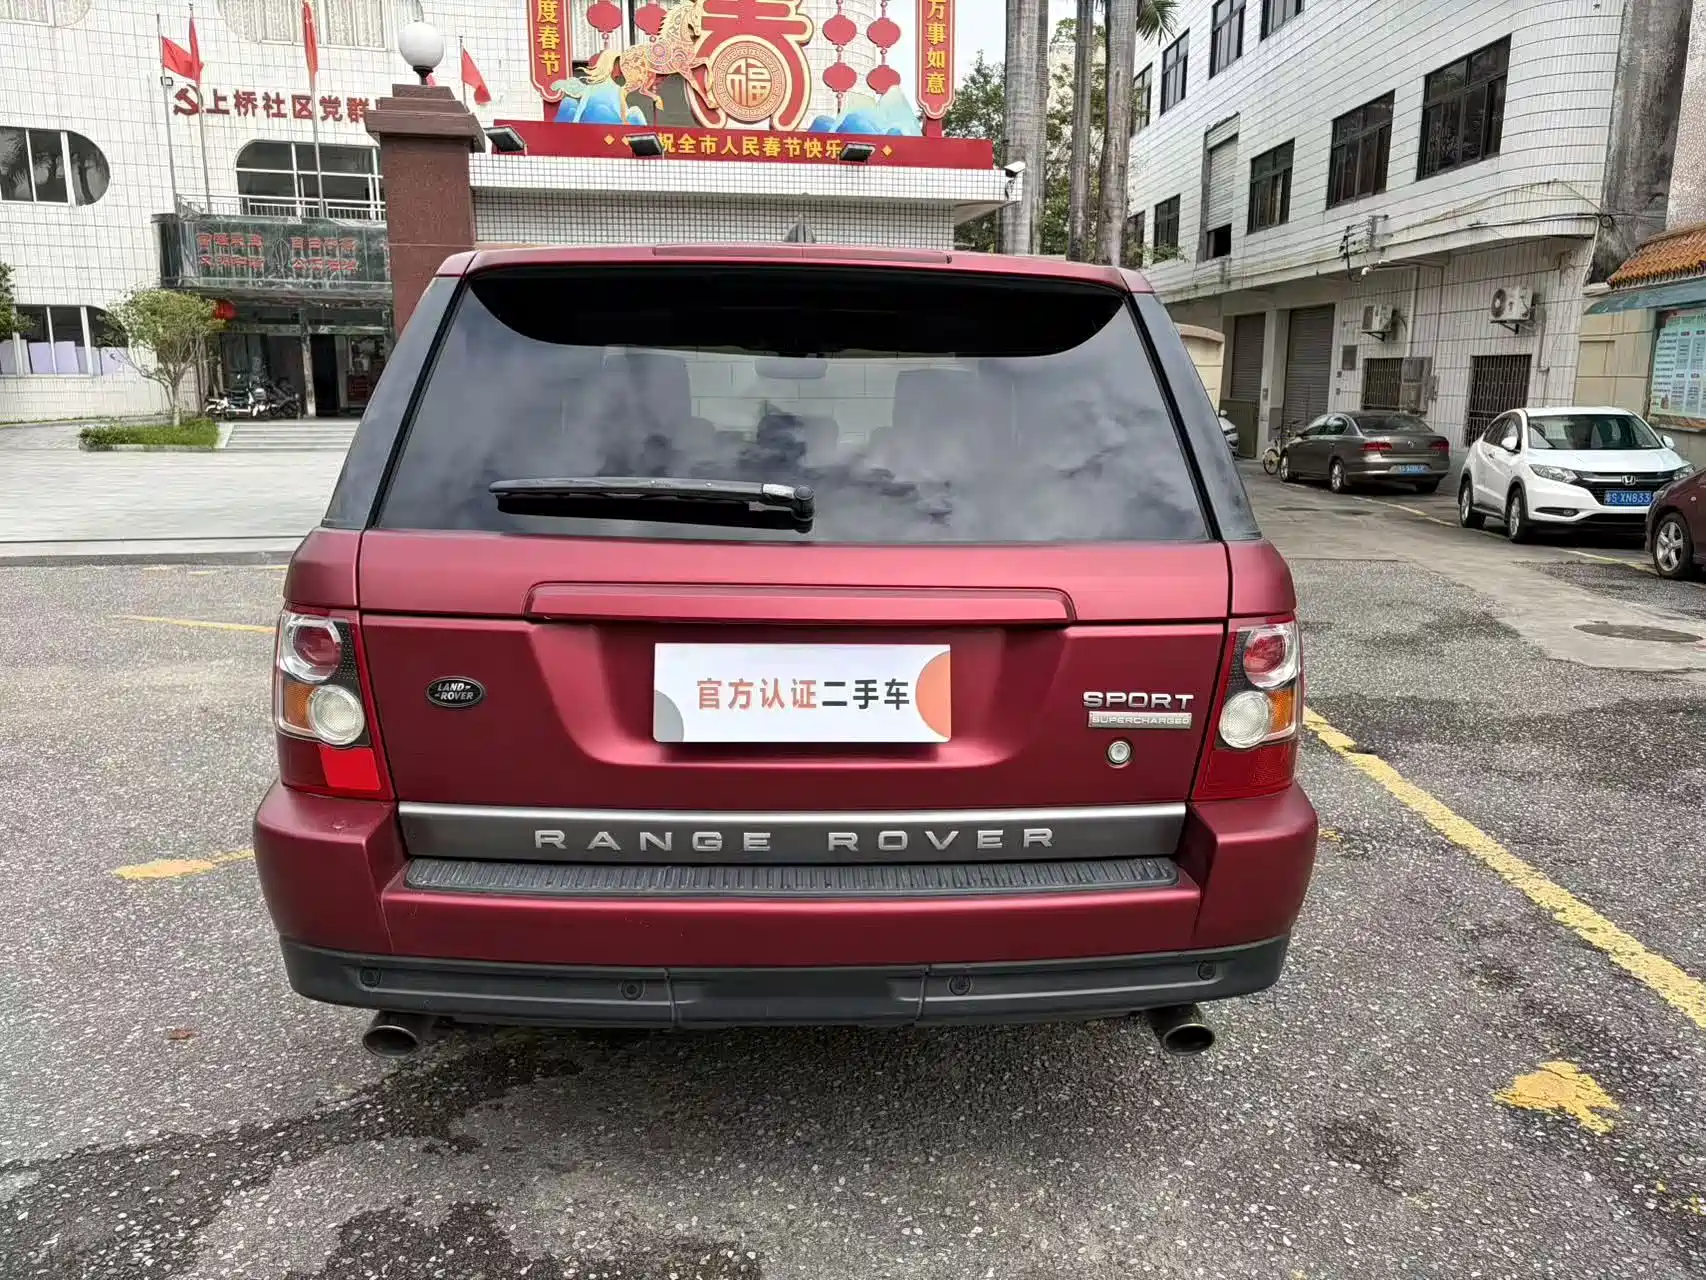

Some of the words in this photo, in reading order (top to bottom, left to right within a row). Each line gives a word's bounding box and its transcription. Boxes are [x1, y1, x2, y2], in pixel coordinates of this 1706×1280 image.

[206, 88, 381, 123] 上桥社区党群
[658, 132, 843, 160] 祝全市人民春节快乐
[697, 677, 910, 710] 官方认证二手车
[1083, 691, 1195, 710] SPORT
[1092, 715, 1190, 725] SUPERCHARGED
[534, 829, 771, 851] RANGE
[827, 828, 1053, 851] ROVER
